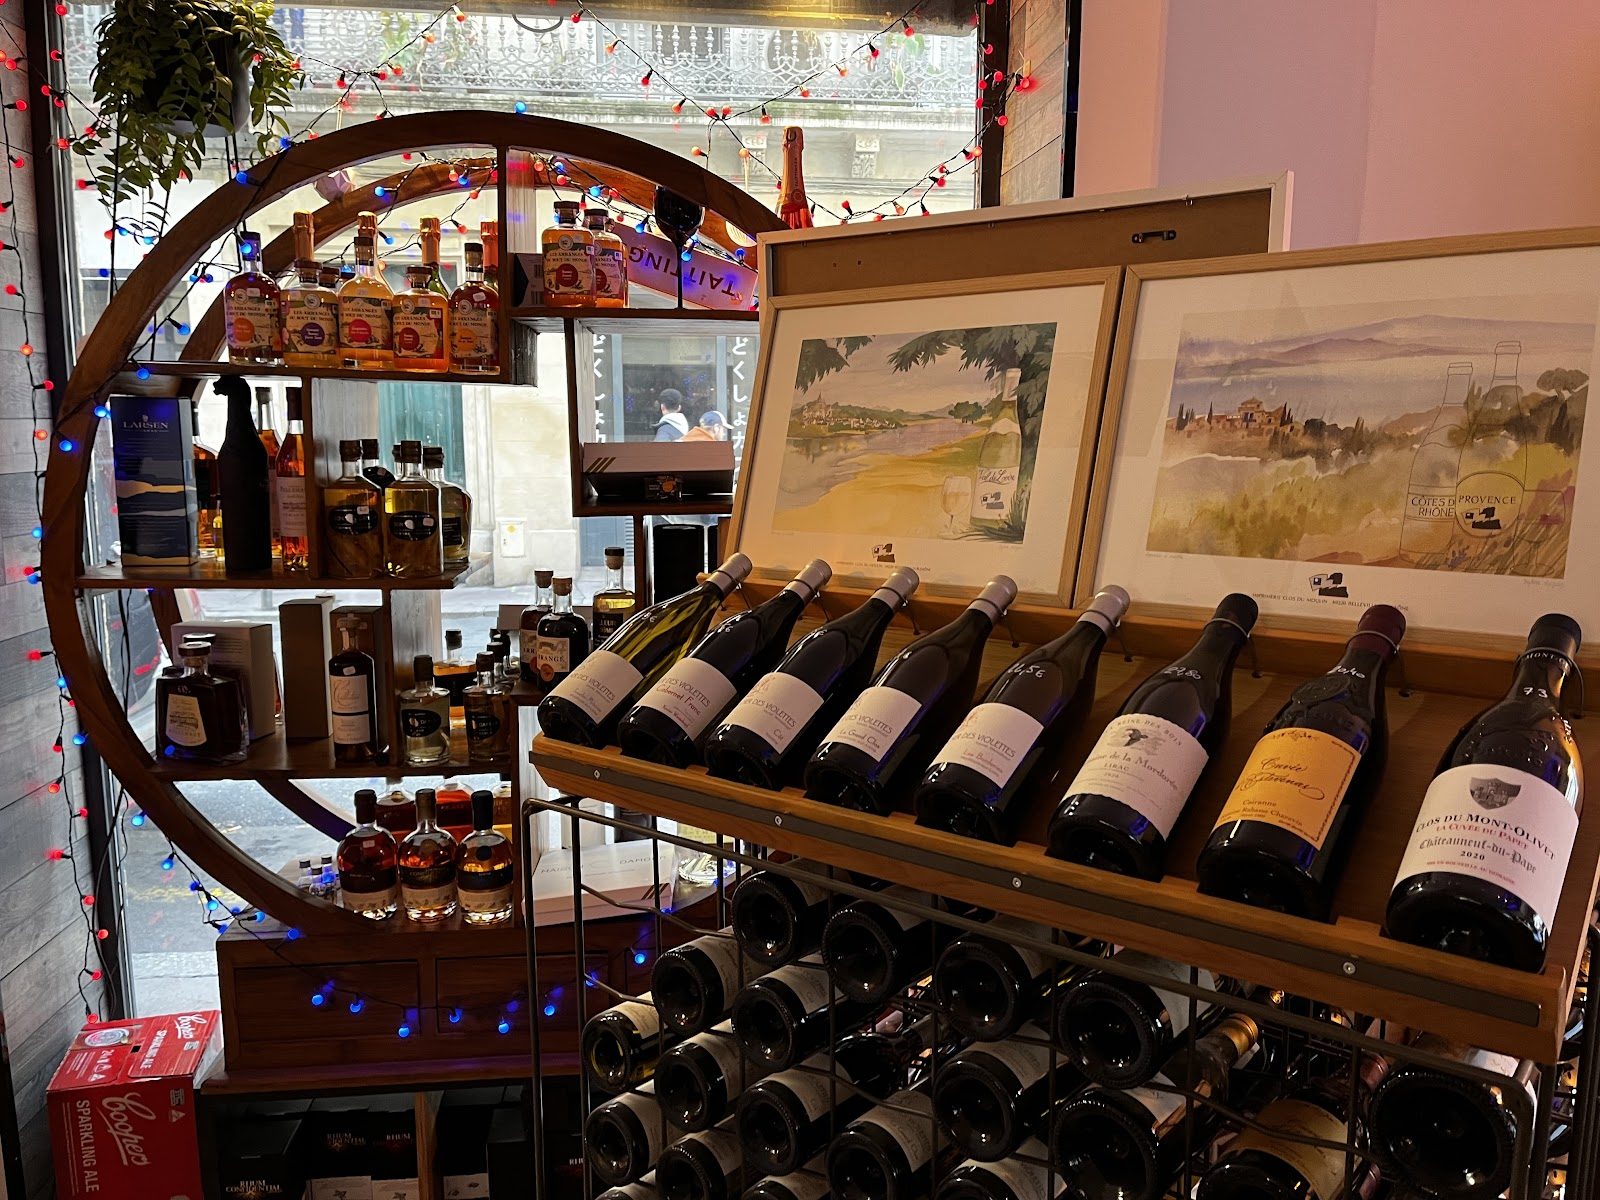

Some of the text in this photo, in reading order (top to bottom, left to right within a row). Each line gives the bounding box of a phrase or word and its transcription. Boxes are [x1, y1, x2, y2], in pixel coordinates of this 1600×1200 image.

[123, 421, 169, 429] LARSEN
[1411, 495, 1446, 507] CÔTES
[1458, 495, 1517, 505] PROVENCE
[1418, 507, 1455, 518] RHÔNE
[679, 681, 711, 708] VIOLETTES
[765, 703, 797, 728] VIOLETTES
[858, 714, 892, 735] VIOLETTES
[977, 735, 1017, 758] VIOLETTES
[1109, 752, 1122, 760] de
[1122, 752, 1132, 762] la
[1103, 763, 1130, 772] LIRAC
[1416, 813, 1555, 861] CLOS DU MONT-OLIVET
[1482, 827, 1497, 836] DU
[1419, 835, 1537, 875] Châteauneuf-du-Pape
[1460, 850, 1485, 861] 2020
[98, 1092, 157, 1167] Coopers
[76, 1099, 100, 1193] SPARKLING ALE
[239, 1180, 267, 1188] RHUM
